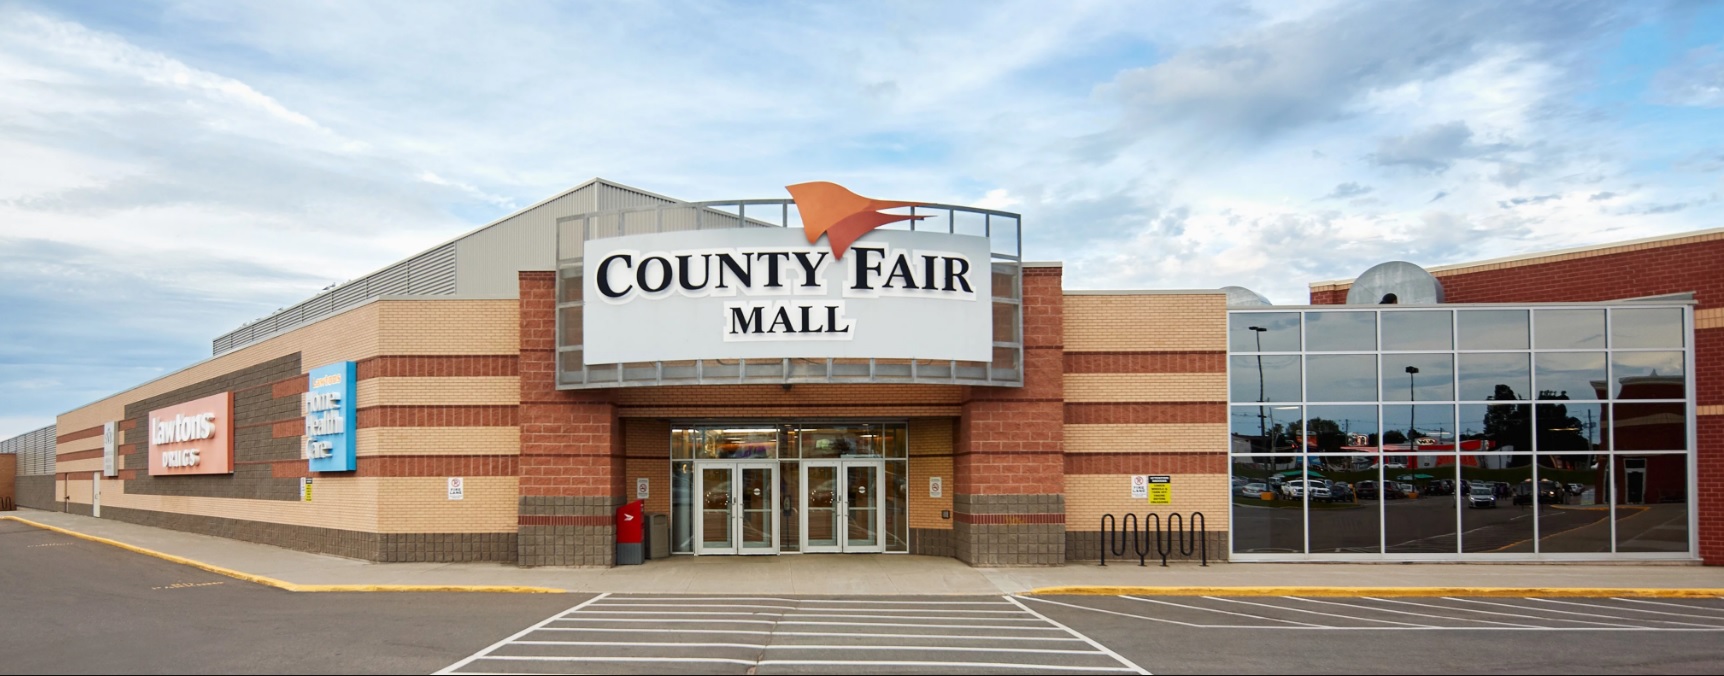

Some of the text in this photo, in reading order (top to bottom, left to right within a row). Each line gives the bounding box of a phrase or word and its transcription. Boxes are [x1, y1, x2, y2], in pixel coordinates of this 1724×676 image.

[596, 246, 974, 298] COUNTY FAIR
[729, 305, 850, 334] MALL
[306, 391, 341, 413] Home
[152, 412, 216, 445] Lawtons
[305, 409, 344, 437] Health
[306, 437, 333, 460] Care
